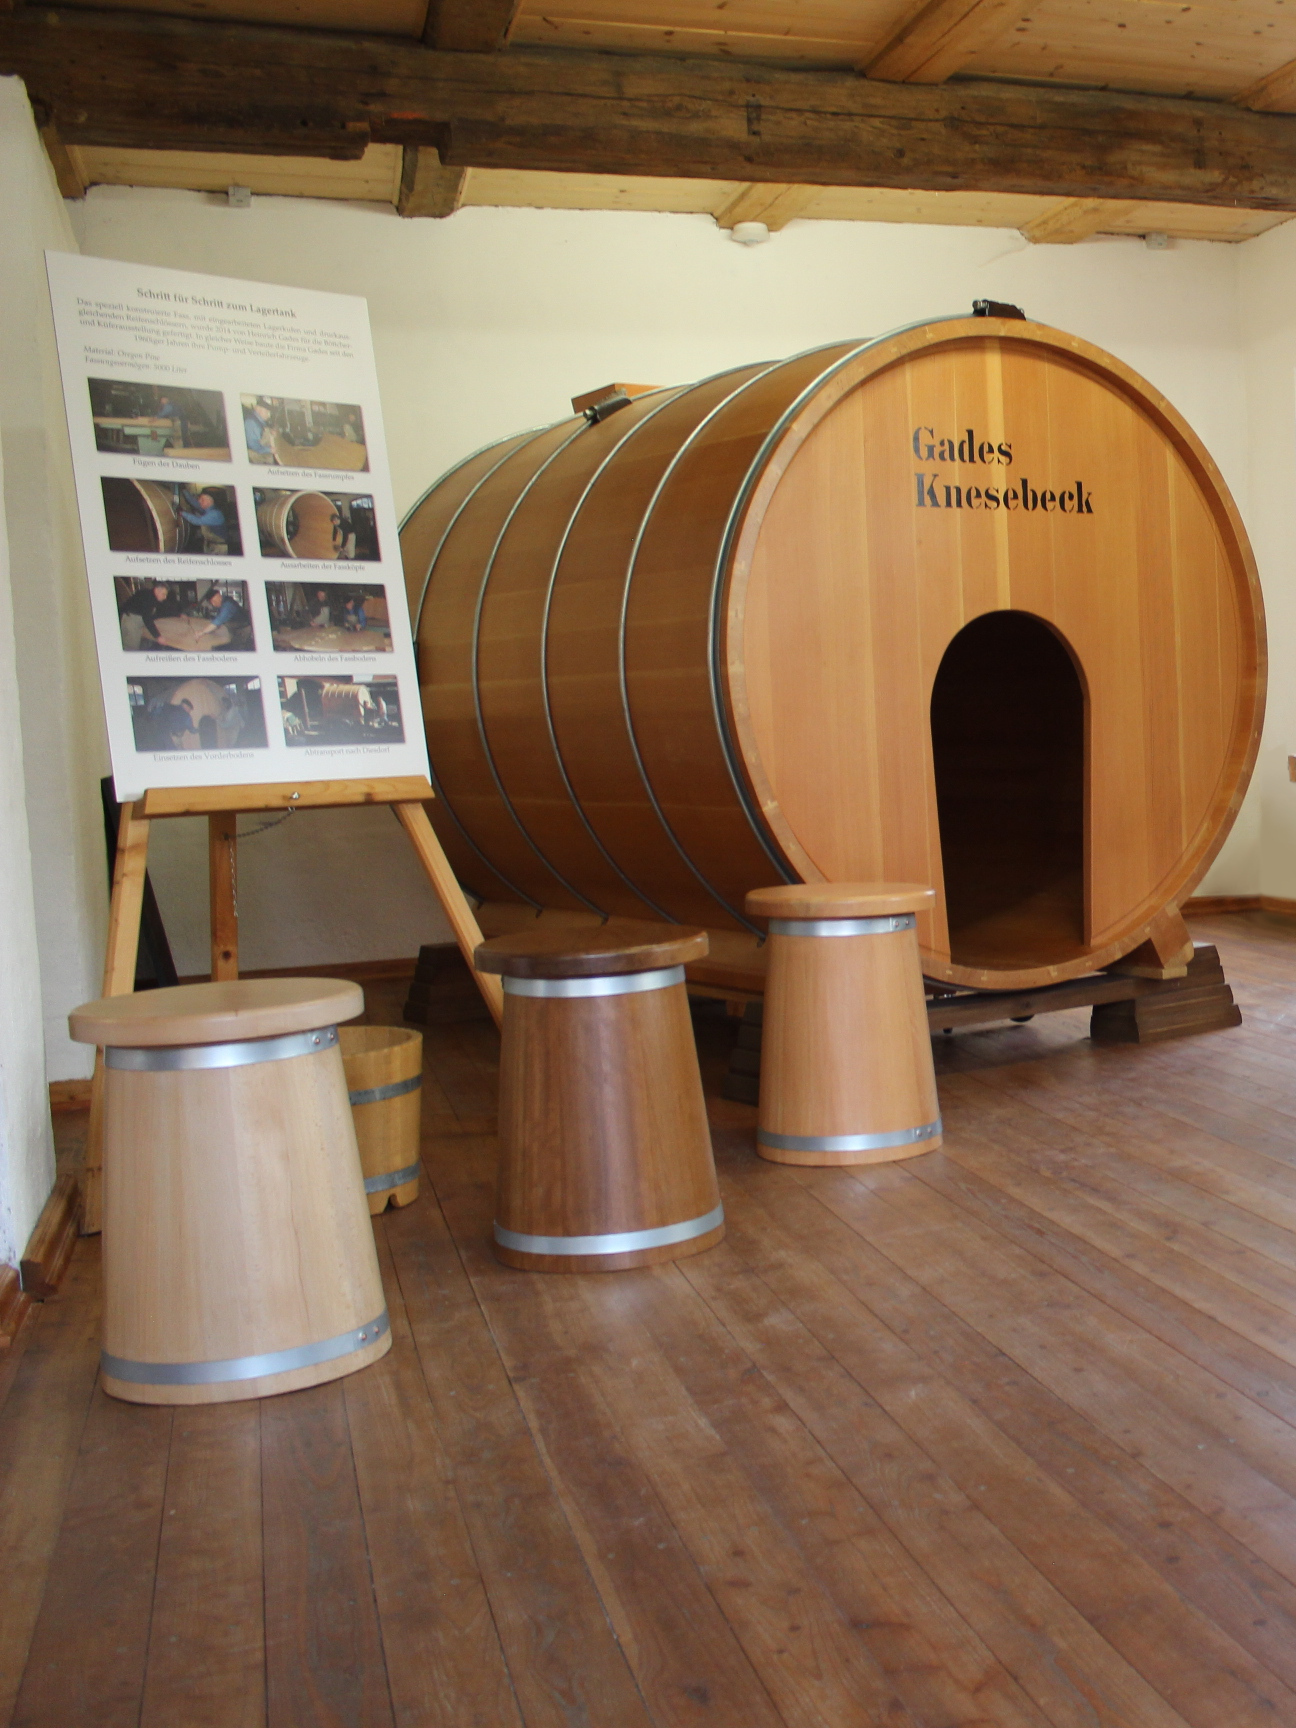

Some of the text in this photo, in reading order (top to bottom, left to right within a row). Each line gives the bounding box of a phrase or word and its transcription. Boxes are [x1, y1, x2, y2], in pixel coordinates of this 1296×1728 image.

[136, 288, 297, 321] Schritt für Schritt zum Lagertank
[912, 426, 1013, 466] Gades
[914, 472, 1094, 514] Knesebeck
